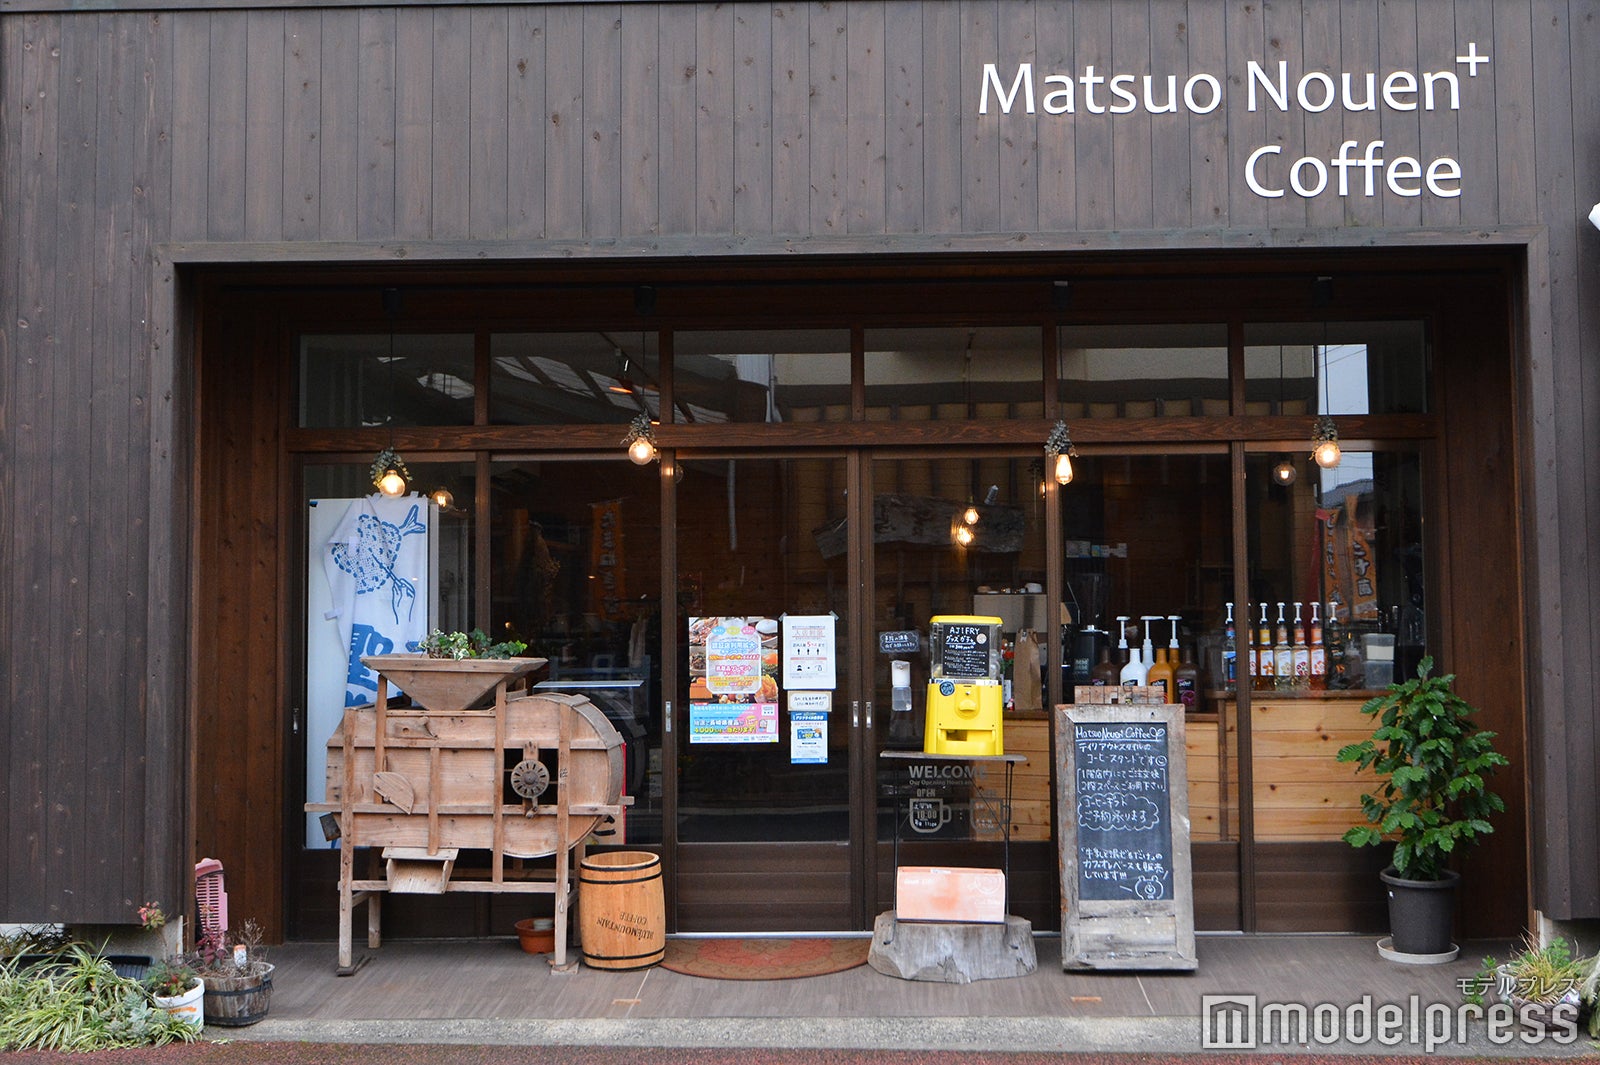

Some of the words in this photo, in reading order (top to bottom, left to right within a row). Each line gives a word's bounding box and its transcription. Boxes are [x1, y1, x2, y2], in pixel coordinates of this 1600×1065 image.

[978, 62, 1222, 115] Matsuo
[1245, 140, 1461, 198] Coffee
[1125, 726, 1152, 739] Coffee
[908, 765, 987, 779] WELCOME
[916, 788, 936, 798] OPEN
